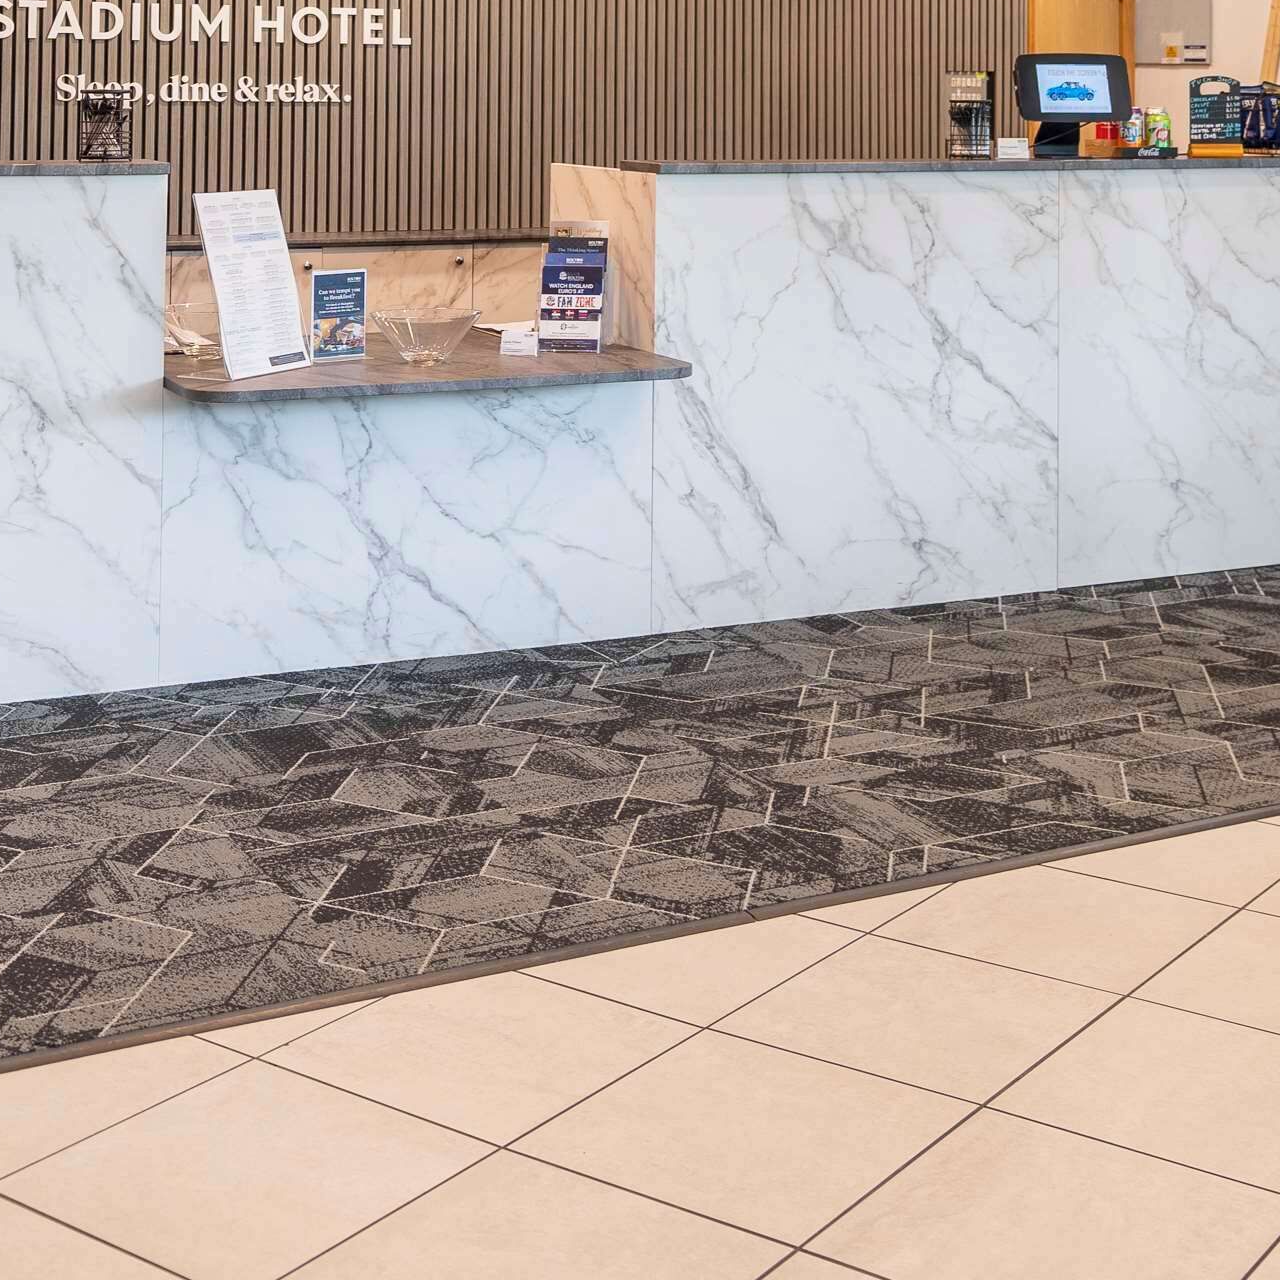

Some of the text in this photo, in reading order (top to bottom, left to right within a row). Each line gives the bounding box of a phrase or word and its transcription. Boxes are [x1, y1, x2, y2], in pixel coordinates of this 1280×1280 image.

[254, 5, 412, 46] HOTEL
[160, 74, 228, 104] dine
[234, 77, 260, 103] &
[265, 76, 353, 104] relax.
[557, 296, 596, 307] FAN ZONE
